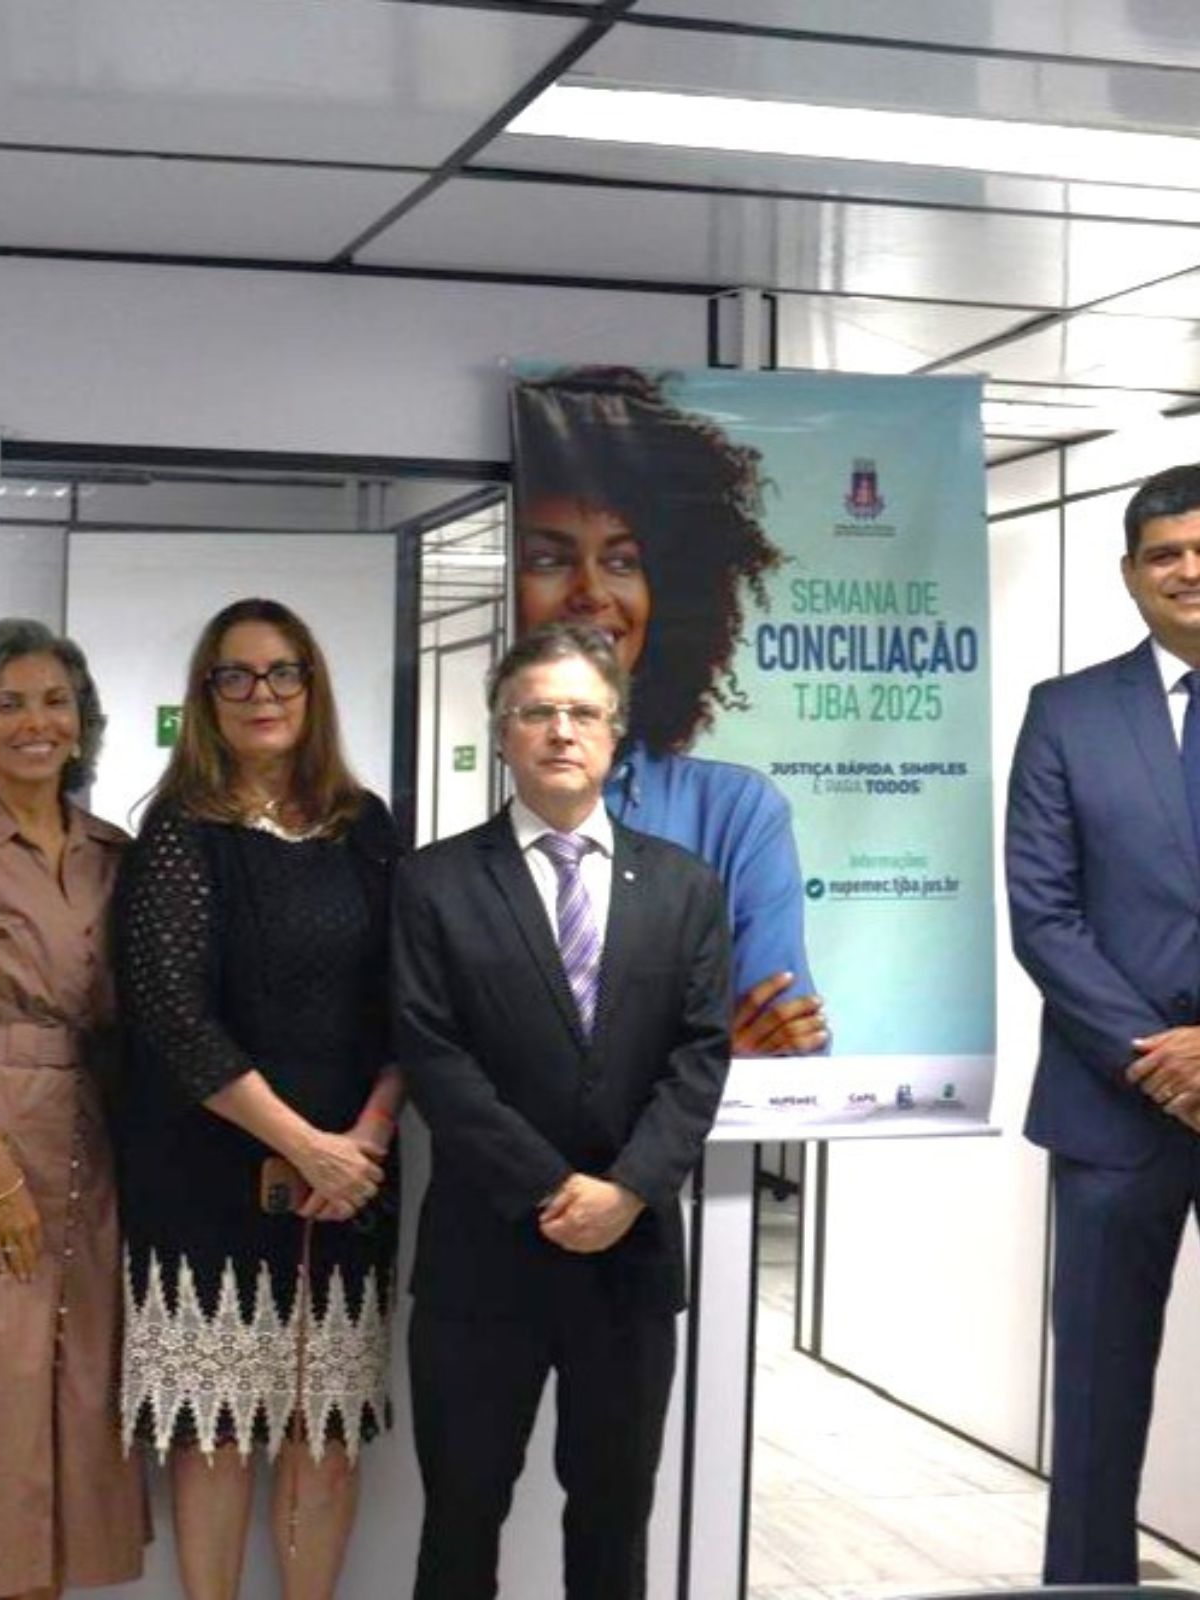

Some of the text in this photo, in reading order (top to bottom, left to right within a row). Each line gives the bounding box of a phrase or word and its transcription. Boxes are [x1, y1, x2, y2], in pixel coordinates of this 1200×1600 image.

[790, 578, 939, 616] SEMANA DE
[756, 620, 979, 679] CONCILIAÇÃO
[793, 682, 942, 721] TJBA 2025
[865, 779, 921, 795] TODOS
